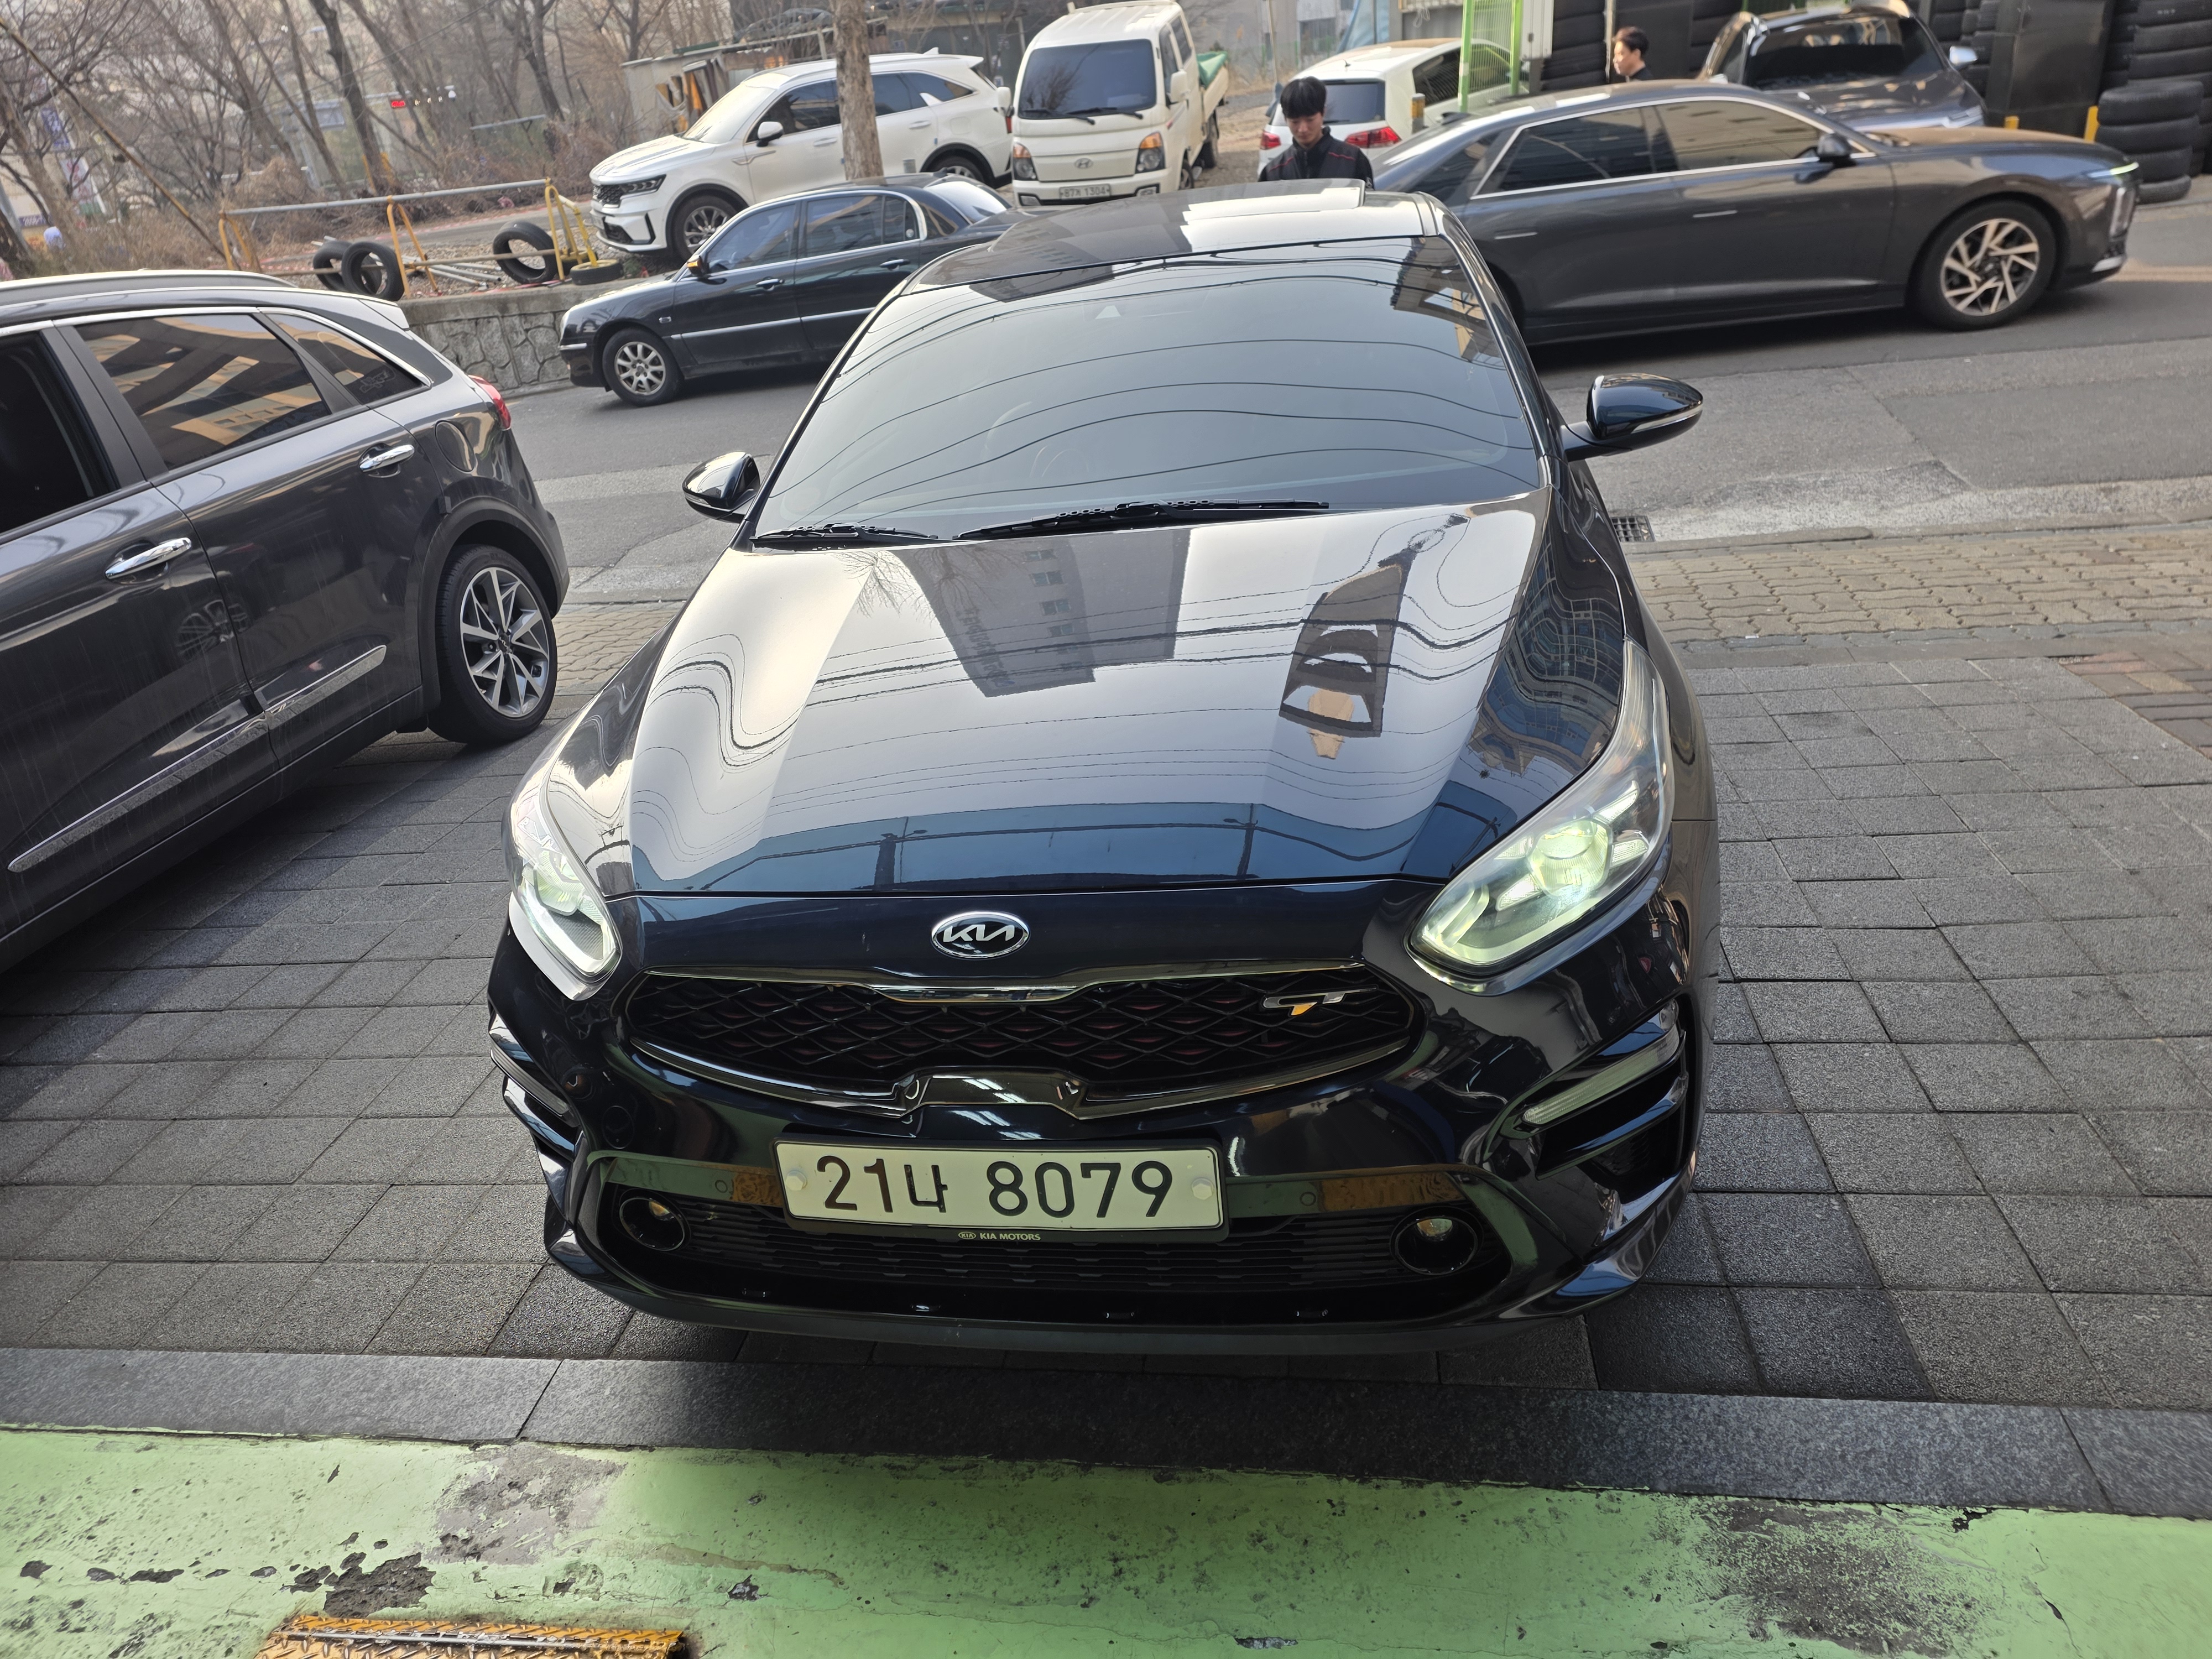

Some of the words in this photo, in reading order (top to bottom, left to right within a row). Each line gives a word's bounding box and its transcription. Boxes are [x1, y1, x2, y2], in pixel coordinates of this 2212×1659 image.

[1084, 186, 1106, 196] 1304
[1262, 987, 1377, 1015] GT
[817, 1155, 948, 1213] 21나
[987, 1160, 1173, 1218] 8079
